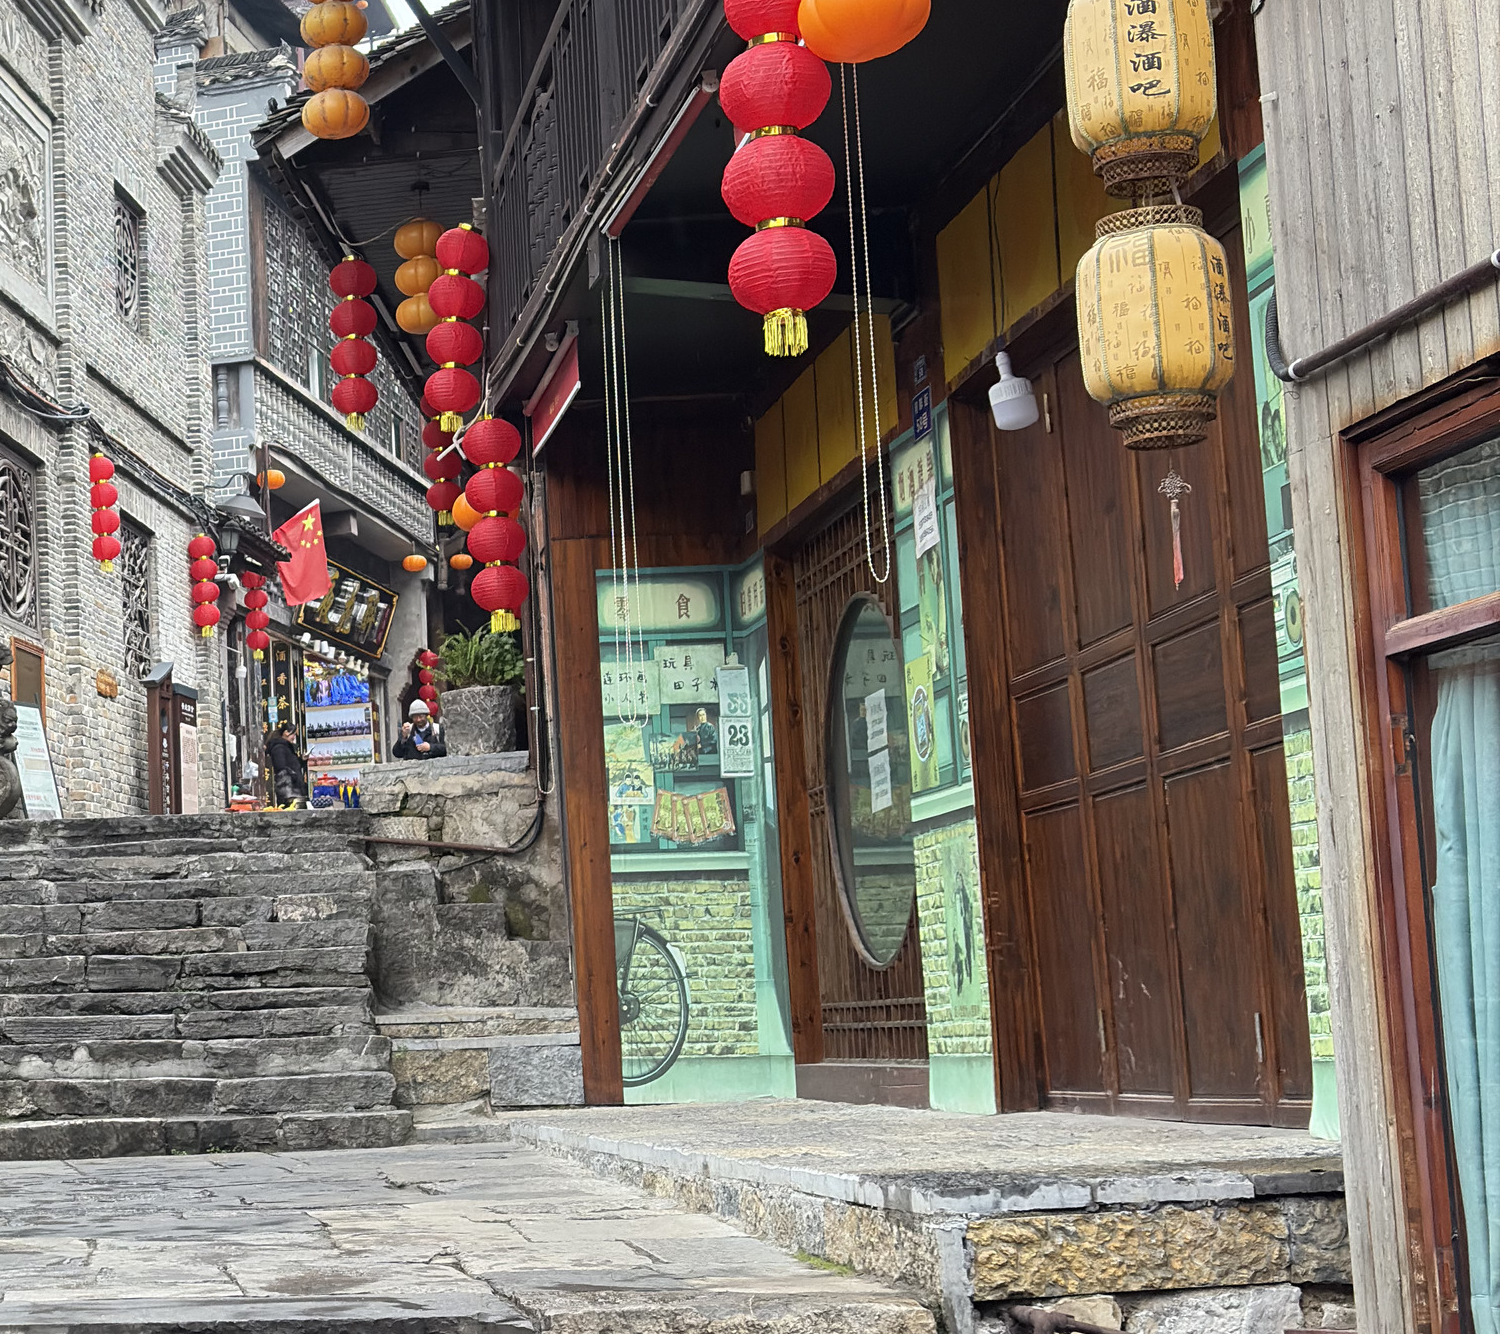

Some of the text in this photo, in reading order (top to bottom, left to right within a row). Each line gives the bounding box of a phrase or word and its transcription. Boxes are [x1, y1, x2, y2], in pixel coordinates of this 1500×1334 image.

[1109, 232, 1151, 274] 福
[614, 593, 691, 620] 零食
[663, 655, 695, 670] 玩具
[728, 724, 750, 747] 23
